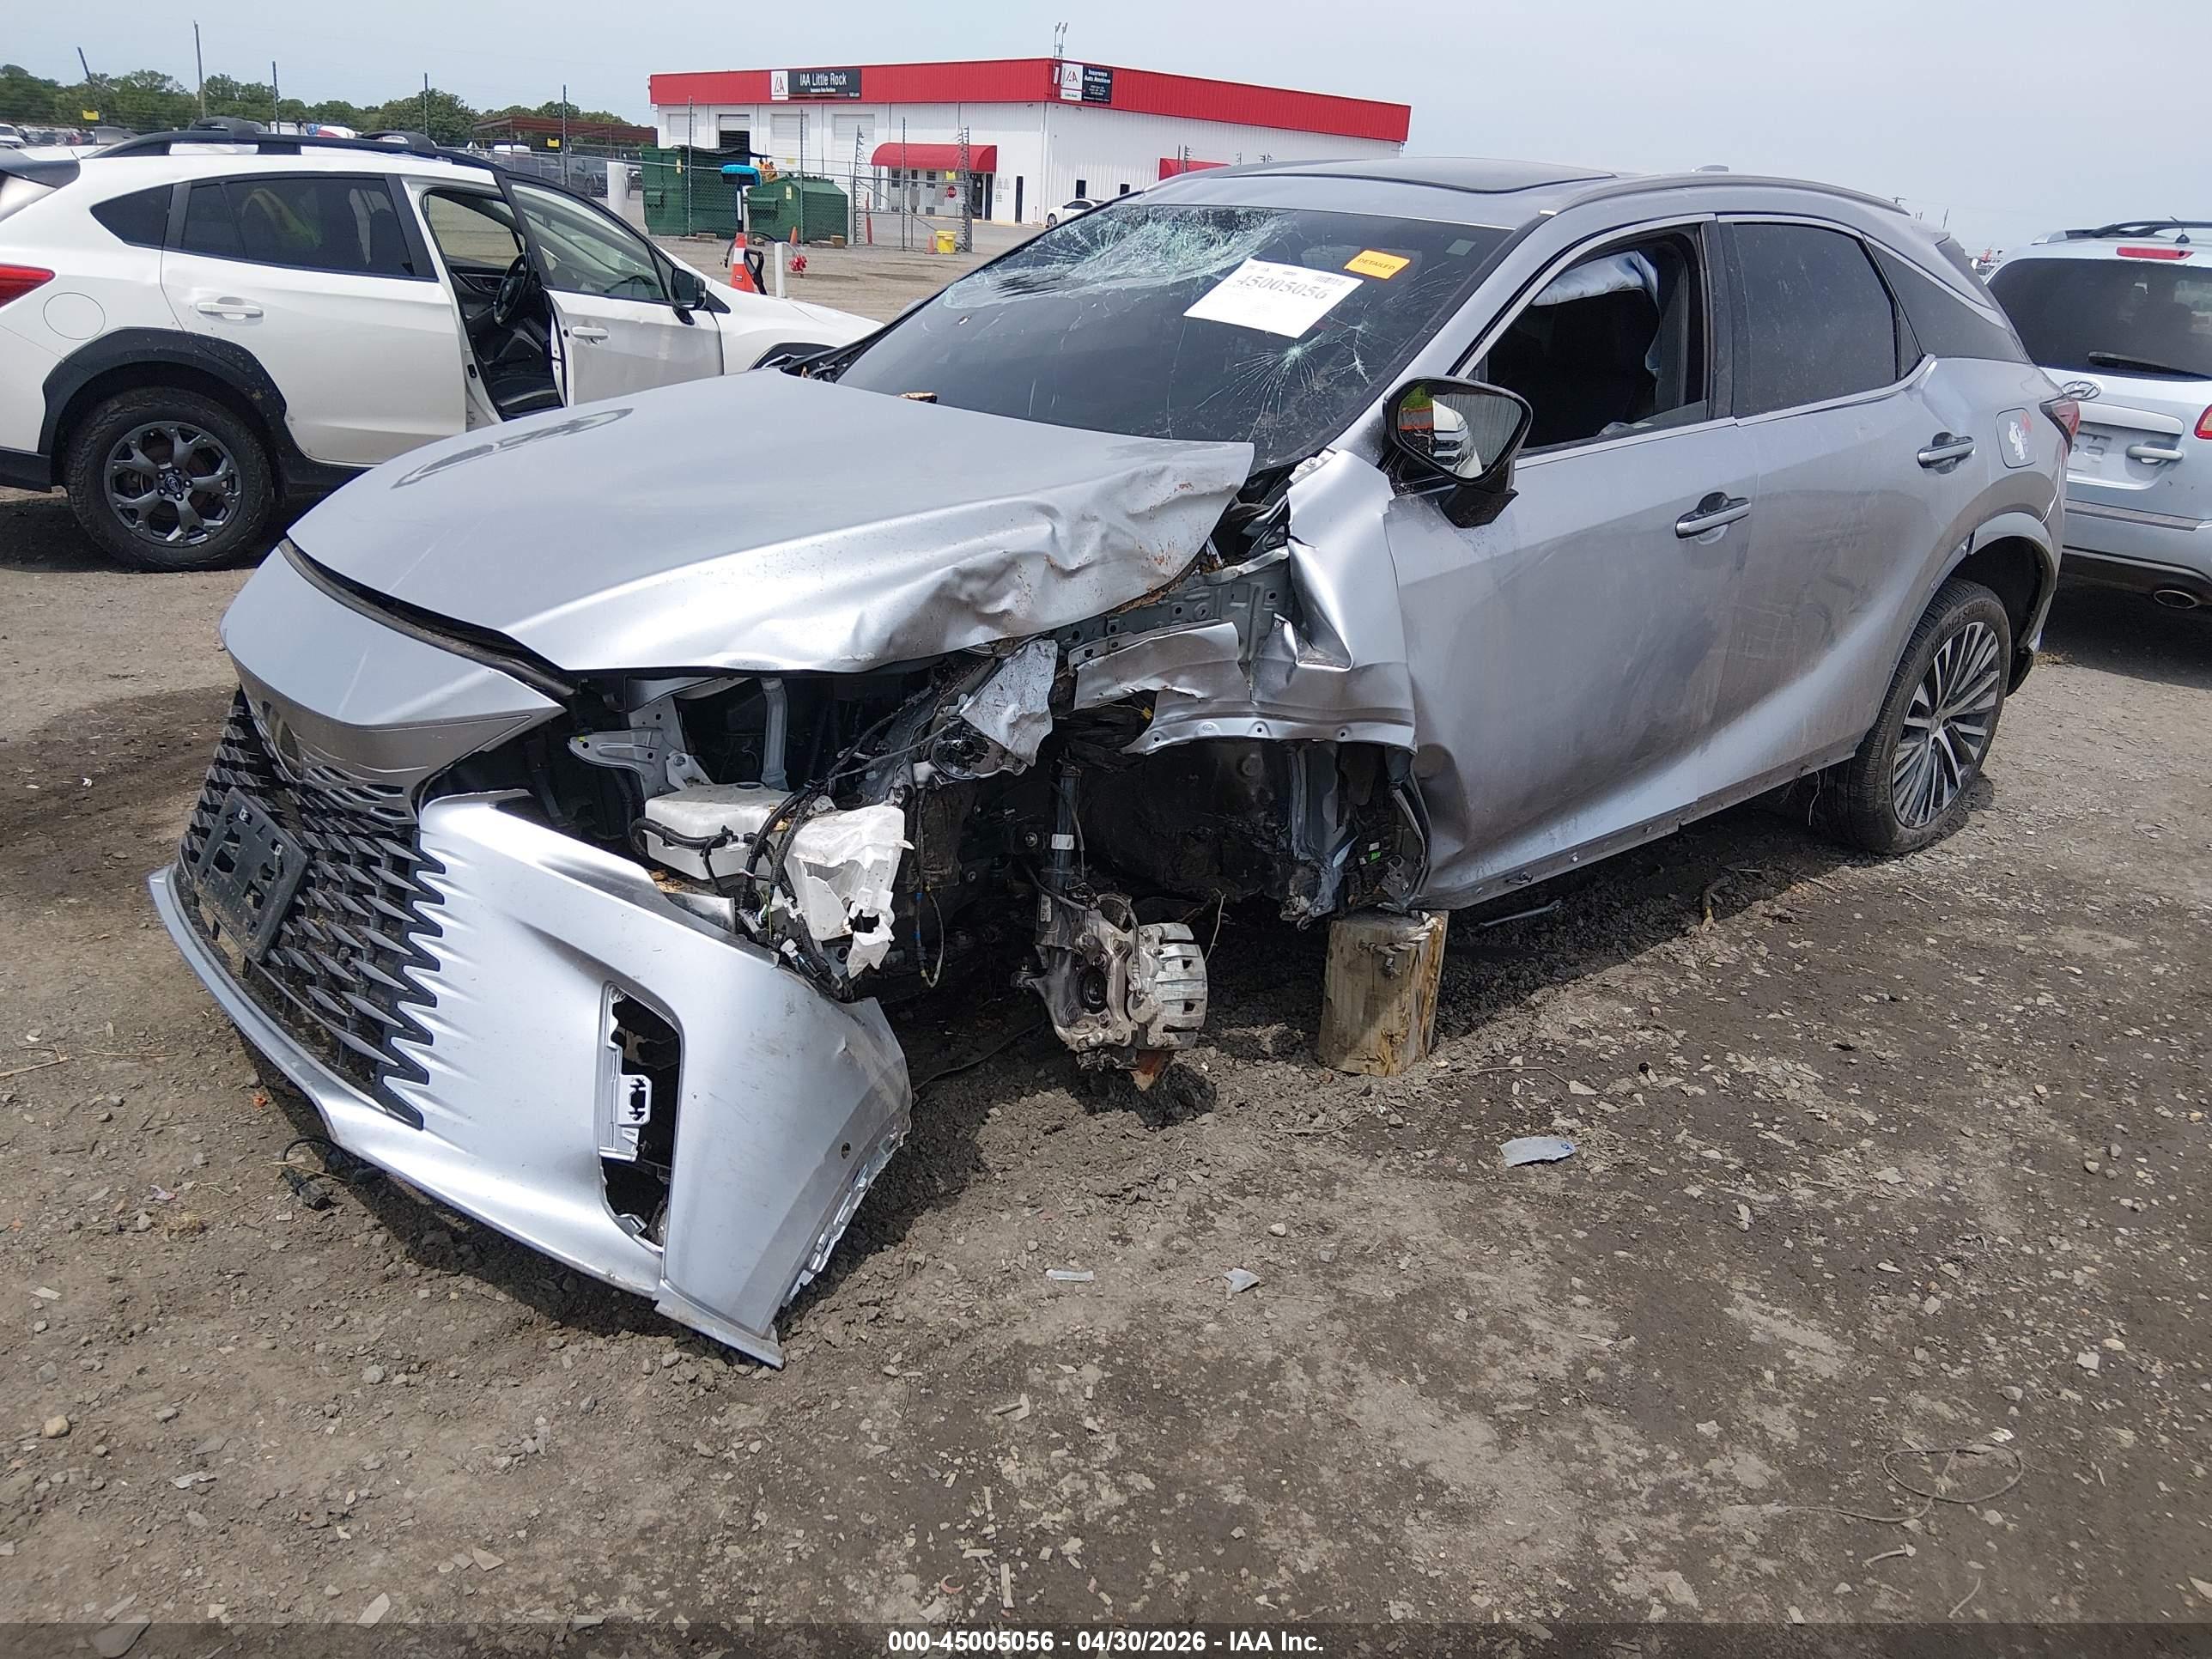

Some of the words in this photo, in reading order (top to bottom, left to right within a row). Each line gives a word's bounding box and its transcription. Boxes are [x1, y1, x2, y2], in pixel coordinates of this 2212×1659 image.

[799, 73, 811, 87] IAA
[811, 73, 829, 86] Little
[830, 72, 847, 86] Rock
[1357, 258, 1395, 270] DETAILED
[1237, 274, 1333, 300] 45005056
